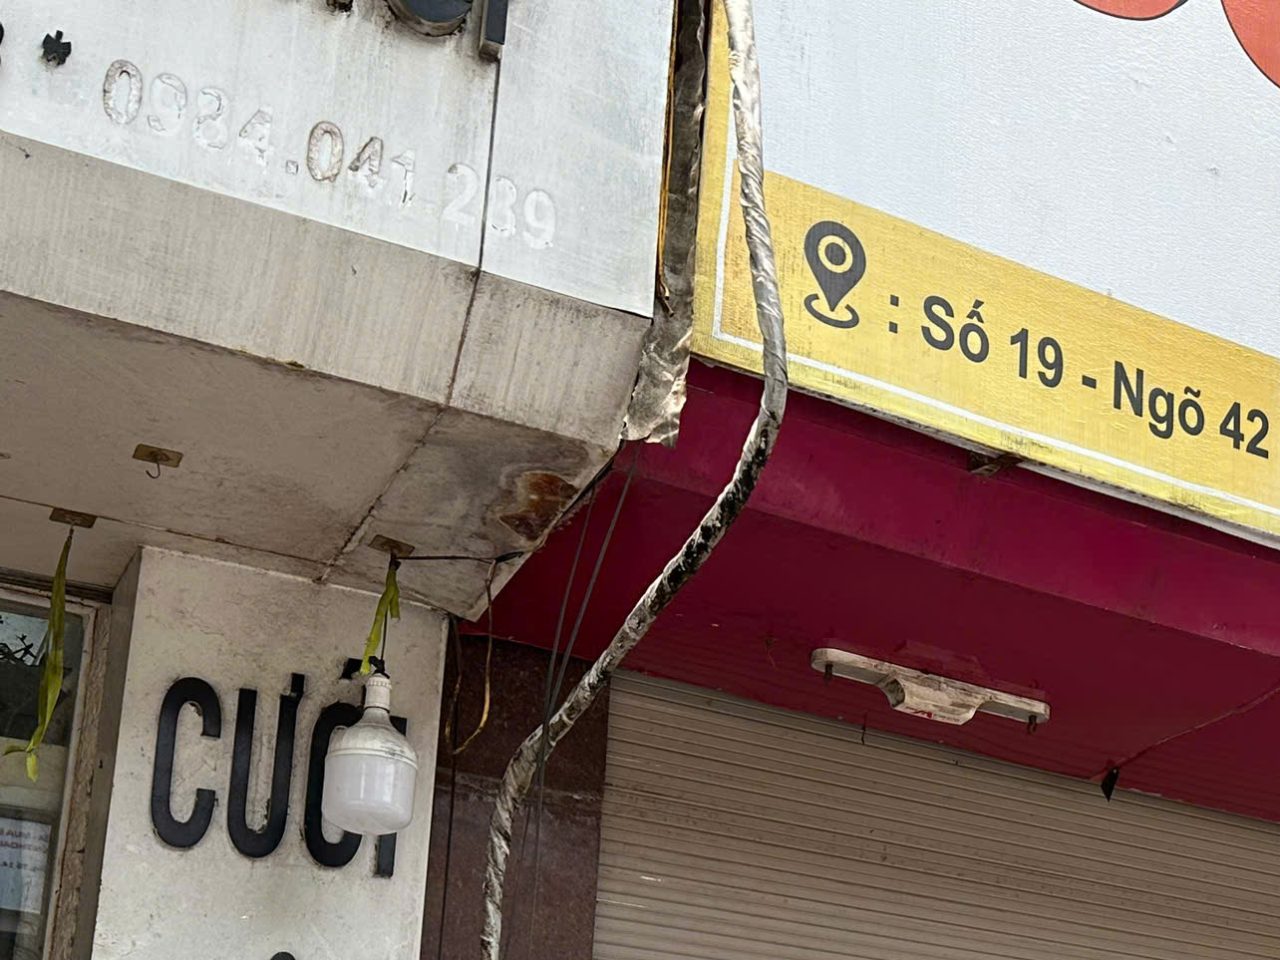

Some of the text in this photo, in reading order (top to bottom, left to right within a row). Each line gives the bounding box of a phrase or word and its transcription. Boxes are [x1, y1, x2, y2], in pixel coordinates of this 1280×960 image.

[921, 295, 990, 364] Số
[1009, 328, 1064, 389] 19
[1113, 361, 1204, 440] Ngõ
[1219, 401, 1270, 459] 42
